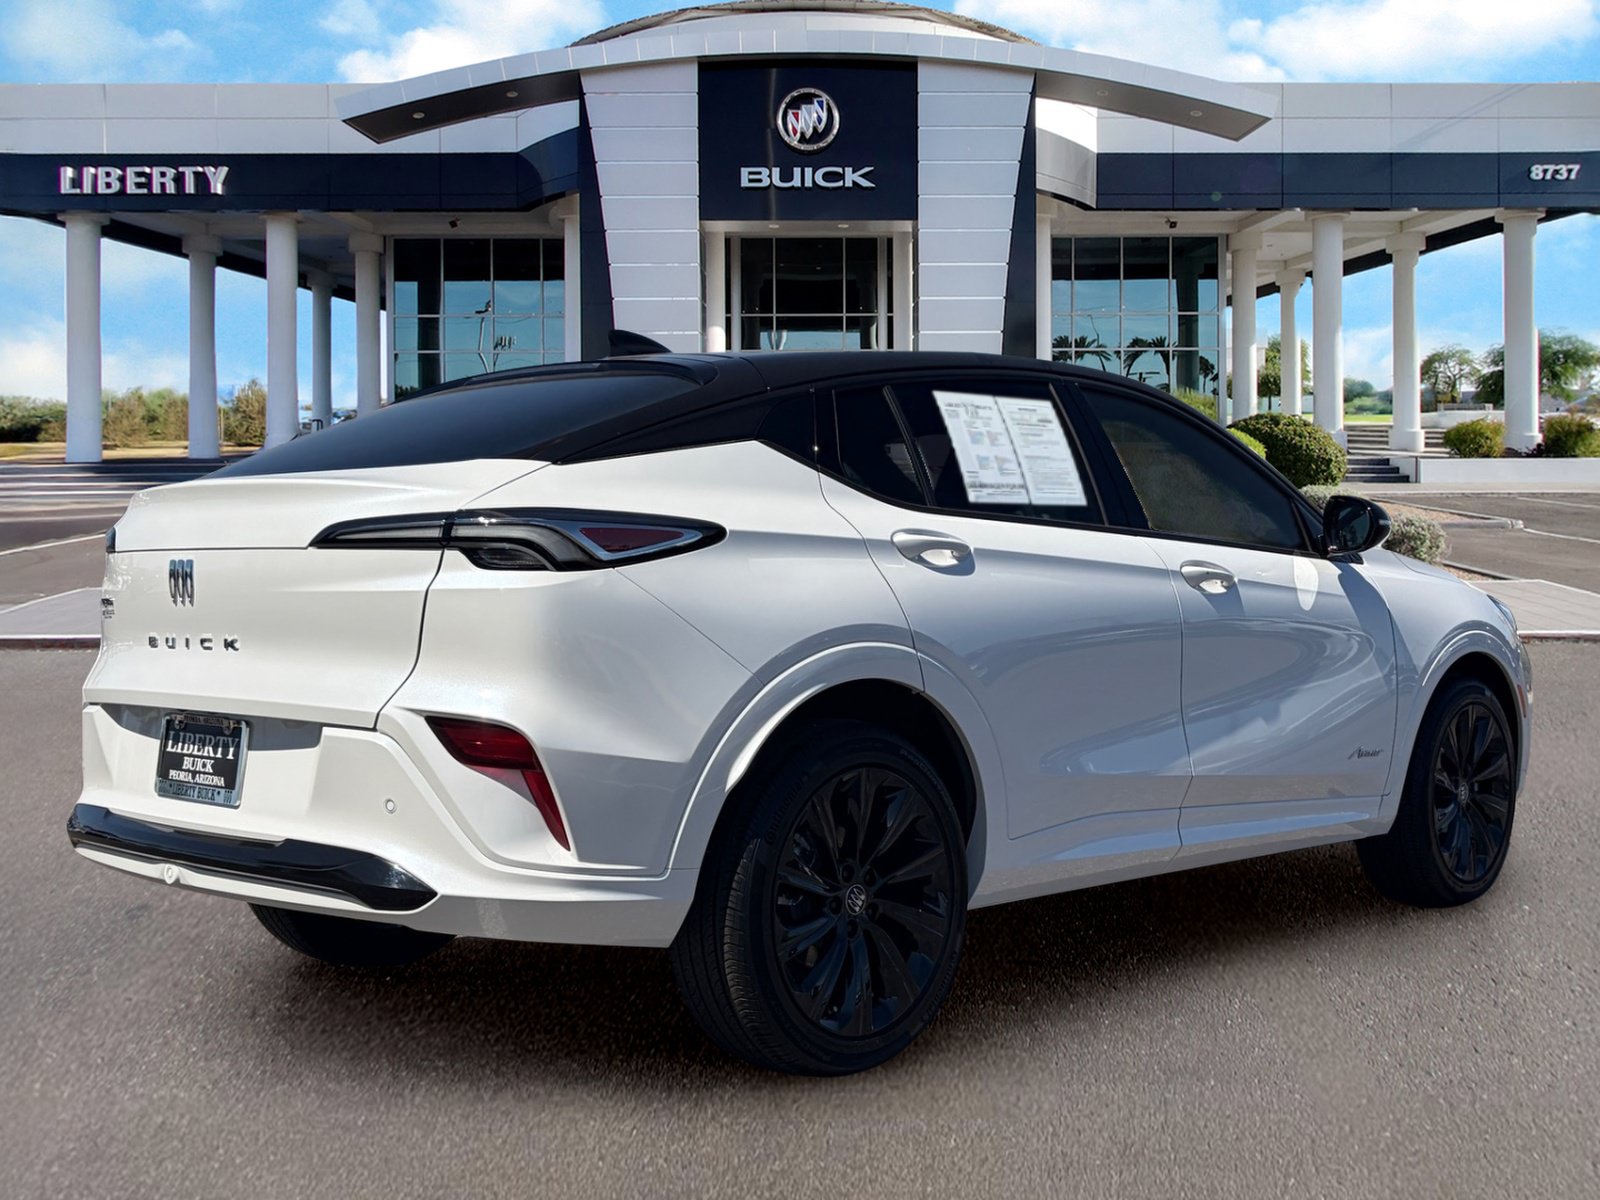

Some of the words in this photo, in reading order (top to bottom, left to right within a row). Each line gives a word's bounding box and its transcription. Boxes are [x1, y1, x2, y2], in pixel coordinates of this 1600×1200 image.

[58, 166, 230, 195] LIBERTY
[739, 166, 876, 189] BUICK
[1529, 163, 1581, 181] 8737
[147, 634, 240, 652] BUICK
[166, 731, 239, 760] LIBERTY
[182, 756, 215, 773] BUICK
[194, 772, 225, 787] ARIZONA
